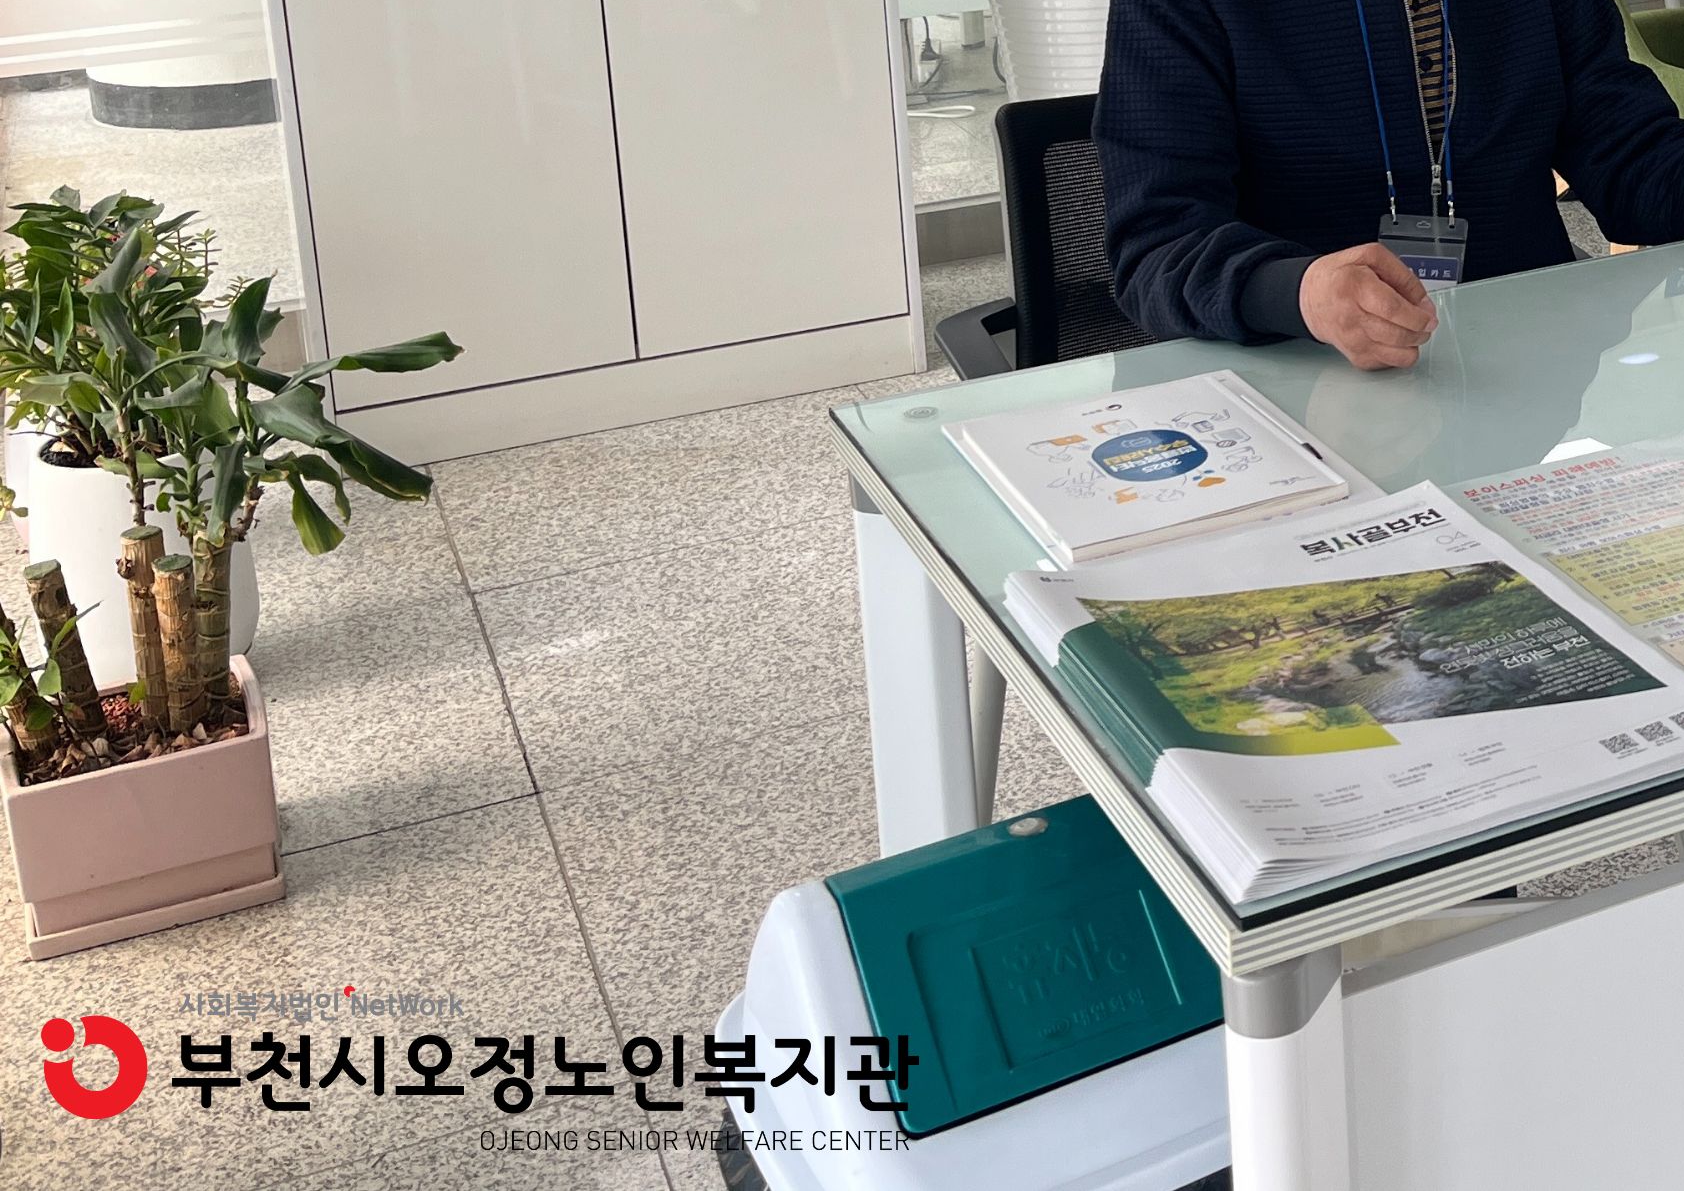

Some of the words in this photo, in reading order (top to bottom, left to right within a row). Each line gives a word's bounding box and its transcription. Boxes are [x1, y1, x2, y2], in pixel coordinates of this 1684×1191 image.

[1460, 474, 1549, 497] 보이스피싱
[1300, 508, 1446, 556] 복사골부천
[1501, 648, 1555, 669] 전하는
[1553, 634, 1591, 652] 부천
